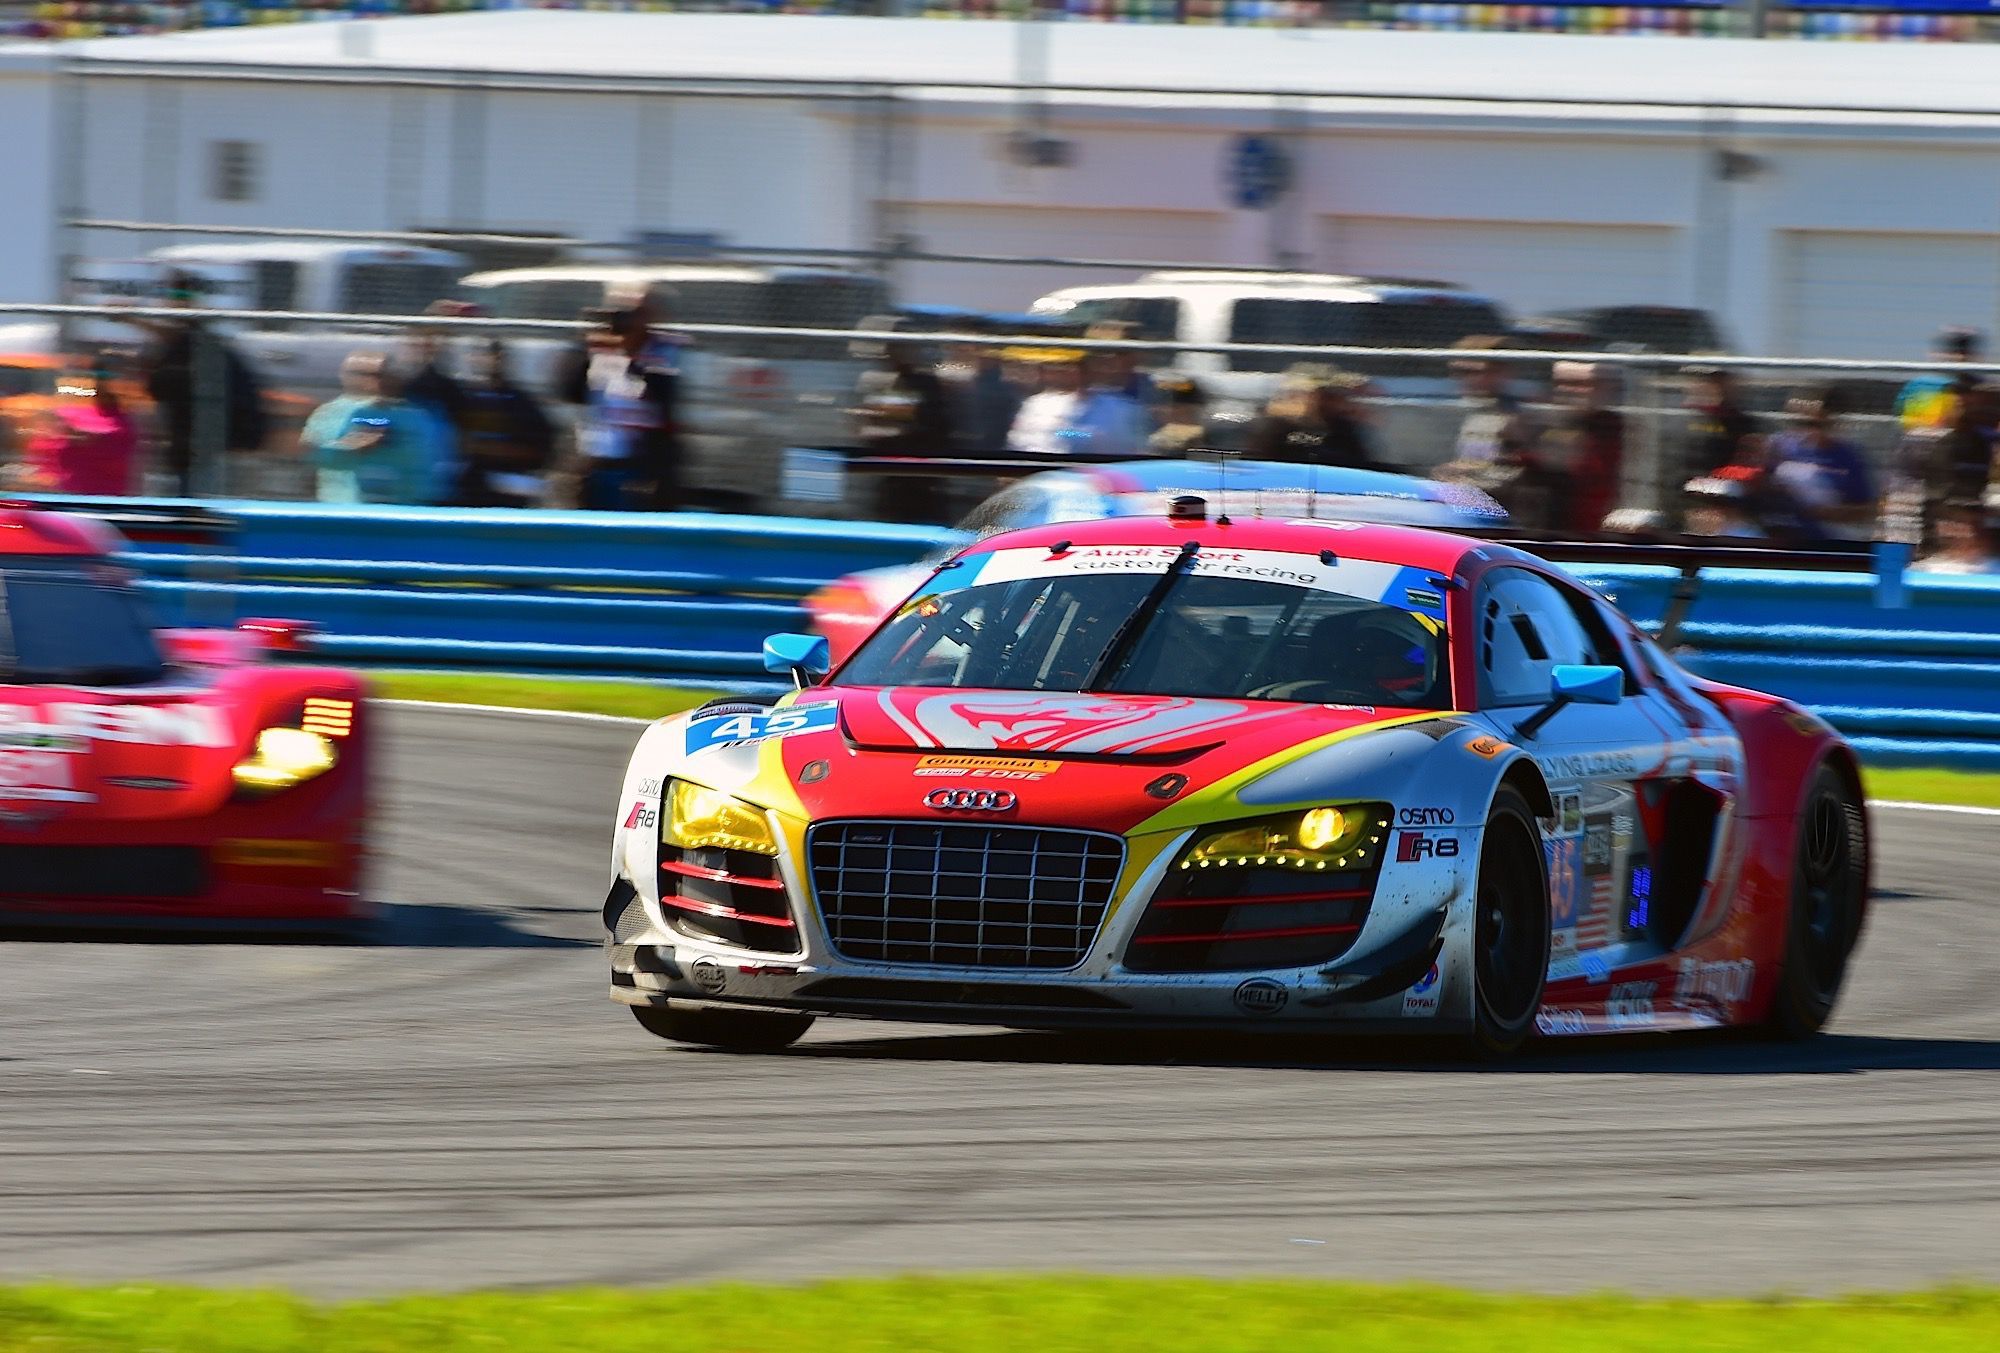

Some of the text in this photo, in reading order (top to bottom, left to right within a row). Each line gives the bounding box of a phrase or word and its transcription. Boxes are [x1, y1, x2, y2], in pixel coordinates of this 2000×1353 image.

[1083, 548, 1245, 561] Audi Sort
[1223, 564, 1318, 585] racing
[711, 711, 809, 739] 45
[926, 756, 1035, 768] Continental
[970, 769, 1048, 781] EDGE
[633, 809, 656, 828] R8
[1410, 837, 1459, 861] R8
[1238, 989, 1287, 1003] HELLA
[1405, 998, 1436, 1008] TOTAL
